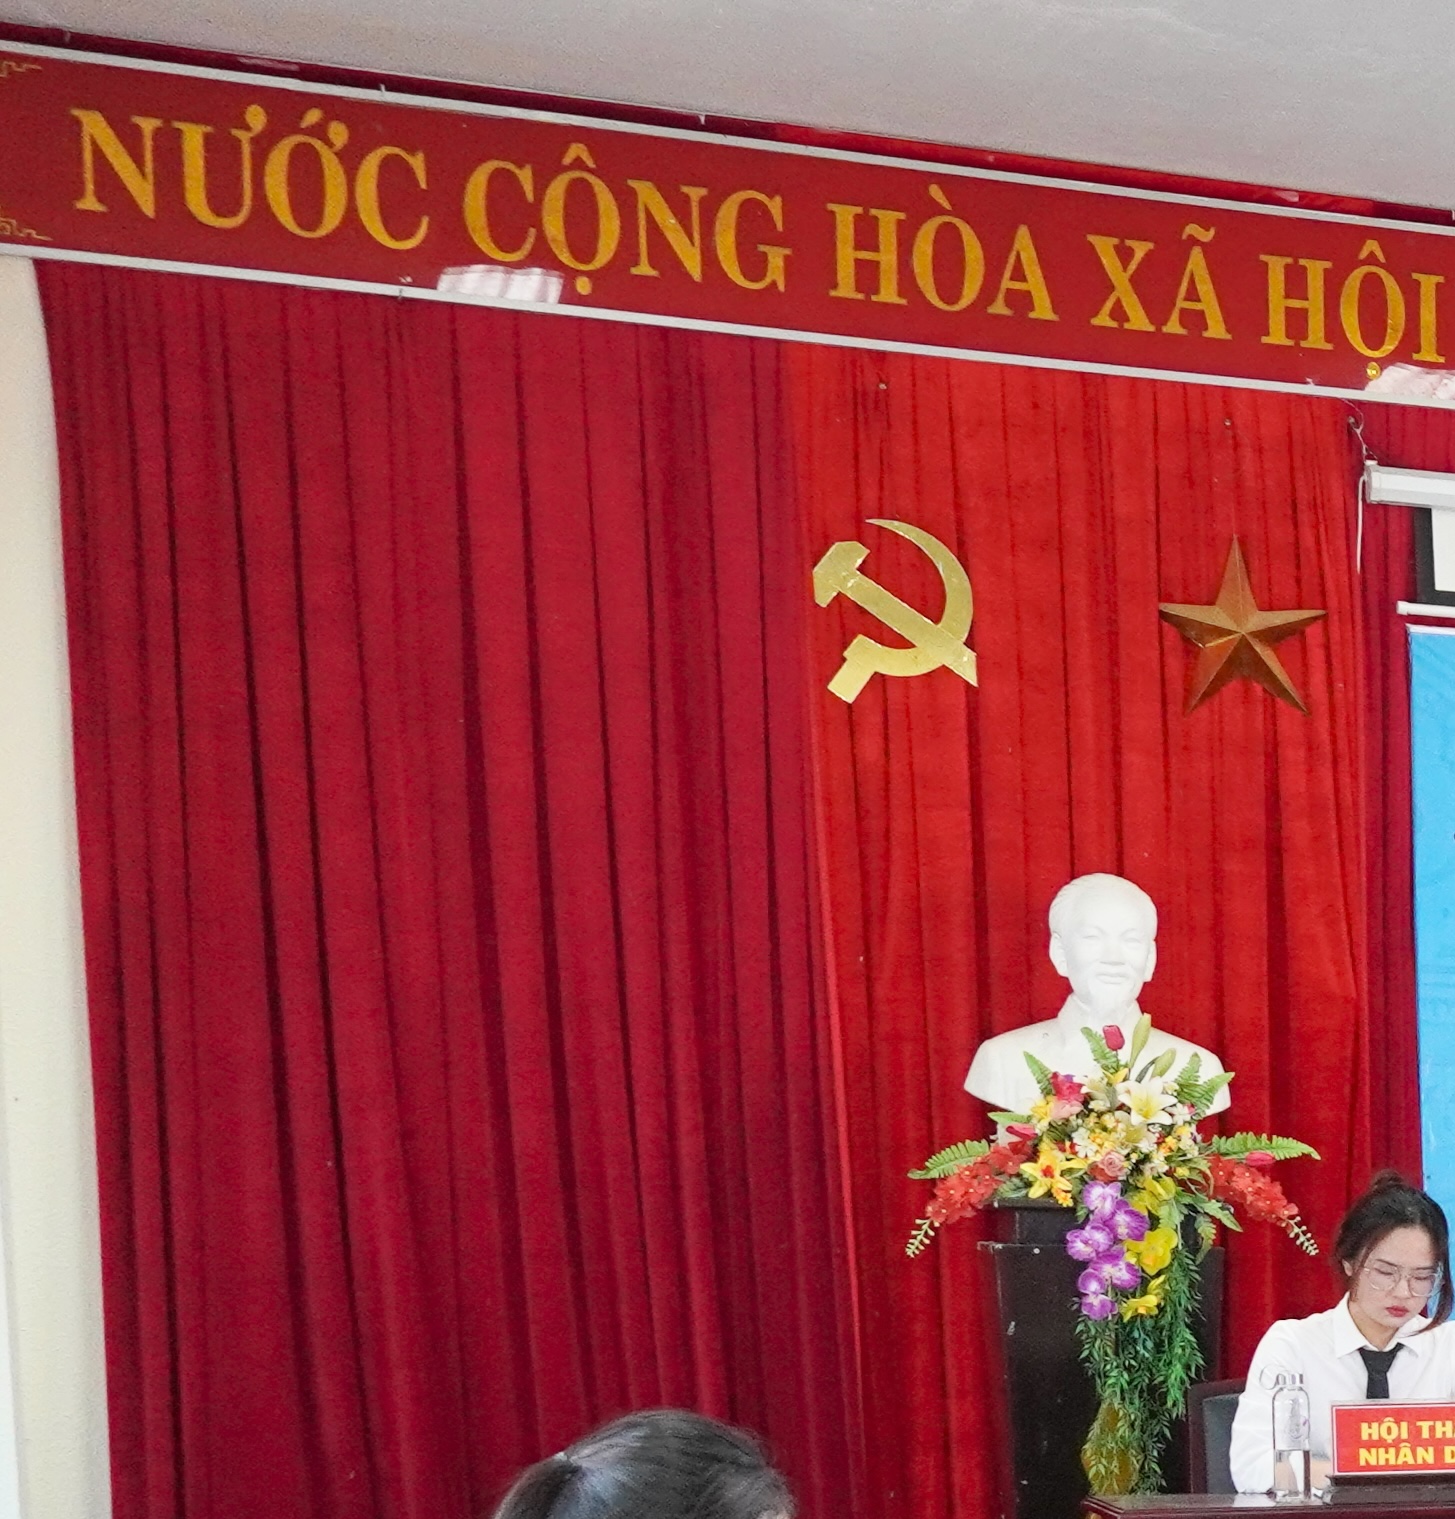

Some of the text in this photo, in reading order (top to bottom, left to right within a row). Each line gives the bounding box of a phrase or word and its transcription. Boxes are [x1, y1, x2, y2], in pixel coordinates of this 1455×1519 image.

[69, 101, 433, 251] NƯỚC
[462, 141, 789, 296] CỘNG
[829, 183, 1063, 323] HÒA
[1085, 221, 1229, 342] XÃ
[1259, 238, 1449, 382] HỘI
[1360, 1416, 1409, 1444] HỘI
[1358, 1442, 1435, 1466] NHÂN
